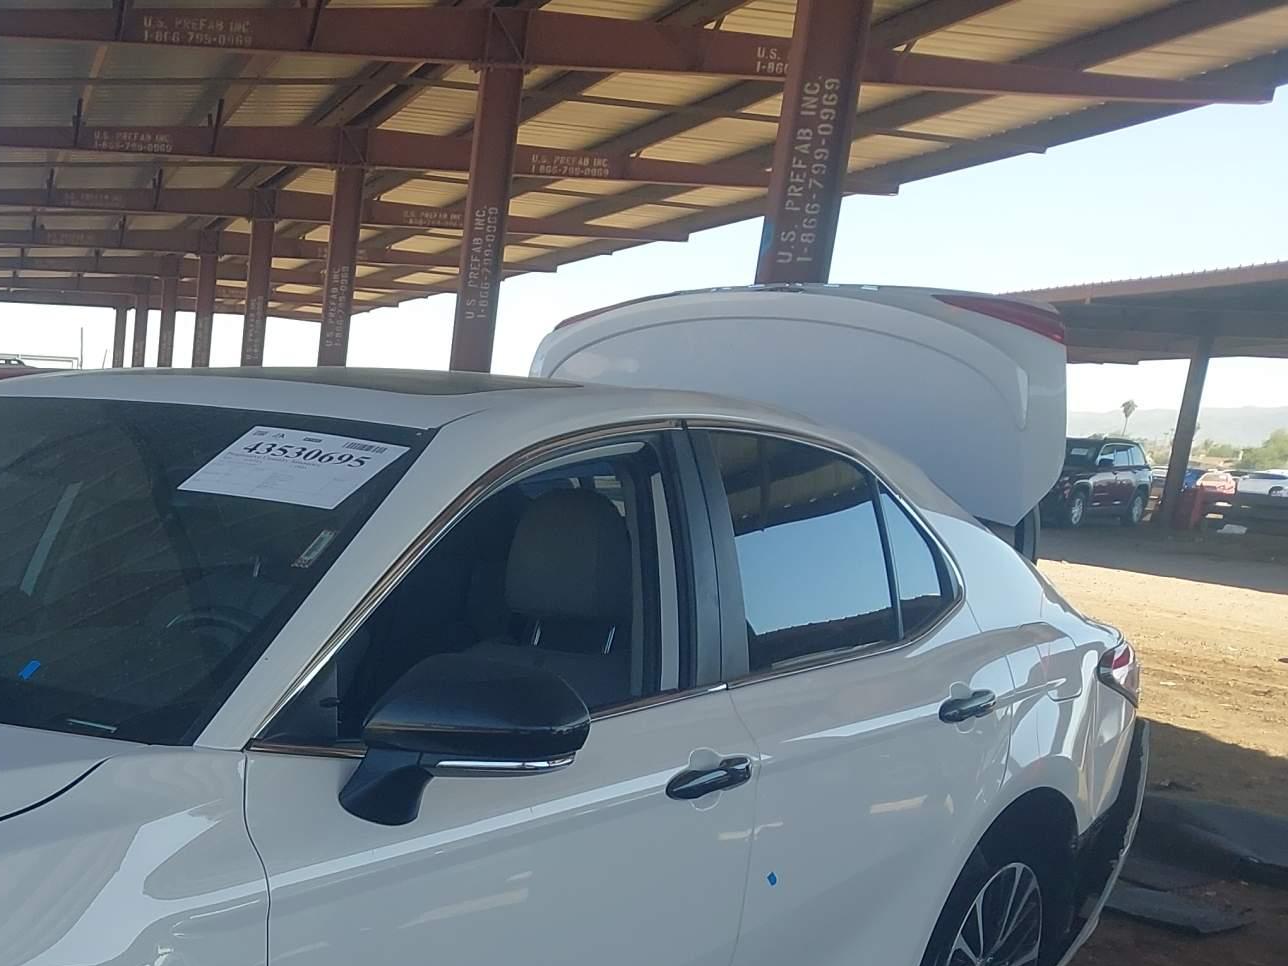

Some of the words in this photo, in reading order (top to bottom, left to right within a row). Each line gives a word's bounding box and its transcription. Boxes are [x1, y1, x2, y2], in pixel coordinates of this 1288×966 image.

[757, 47, 781, 60] U.S.
[800, 75, 823, 116] INC.
[784, 127, 814, 212] PREFAB
[776, 223, 800, 264] U.S.
[243, 441, 372, 468] 43530695
